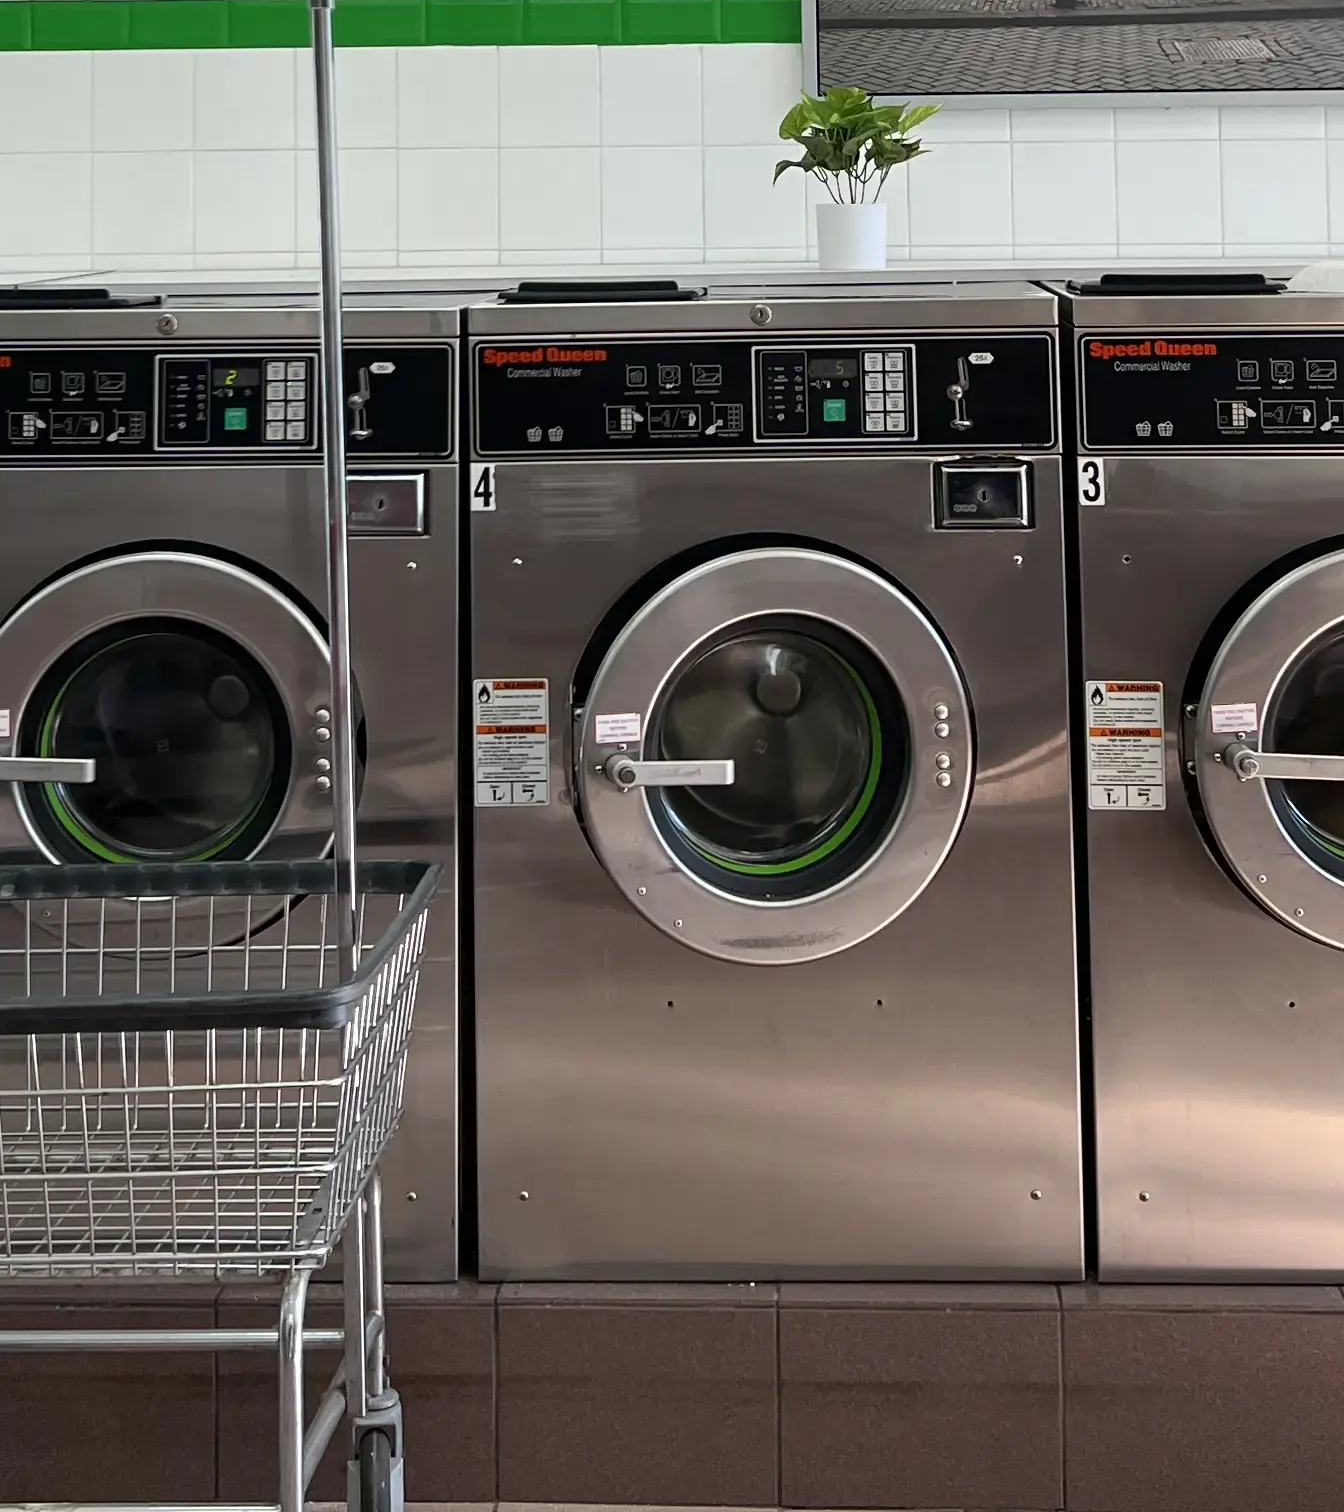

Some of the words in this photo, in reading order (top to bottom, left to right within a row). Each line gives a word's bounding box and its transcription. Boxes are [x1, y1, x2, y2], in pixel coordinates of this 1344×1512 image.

[484, 348, 543, 367] Speed
[546, 347, 607, 363] Queen
[1090, 341, 1152, 359] Speed
[1154, 340, 1217, 356] Queen
[507, 368, 552, 378] Commercial
[552, 367, 582, 377] Washer
[1114, 361, 1160, 371] Commercial
[1161, 360, 1192, 371] Washer
[225, 369, 238, 386] 2
[474, 467, 493, 507] 4
[1082, 461, 1100, 502] 3
